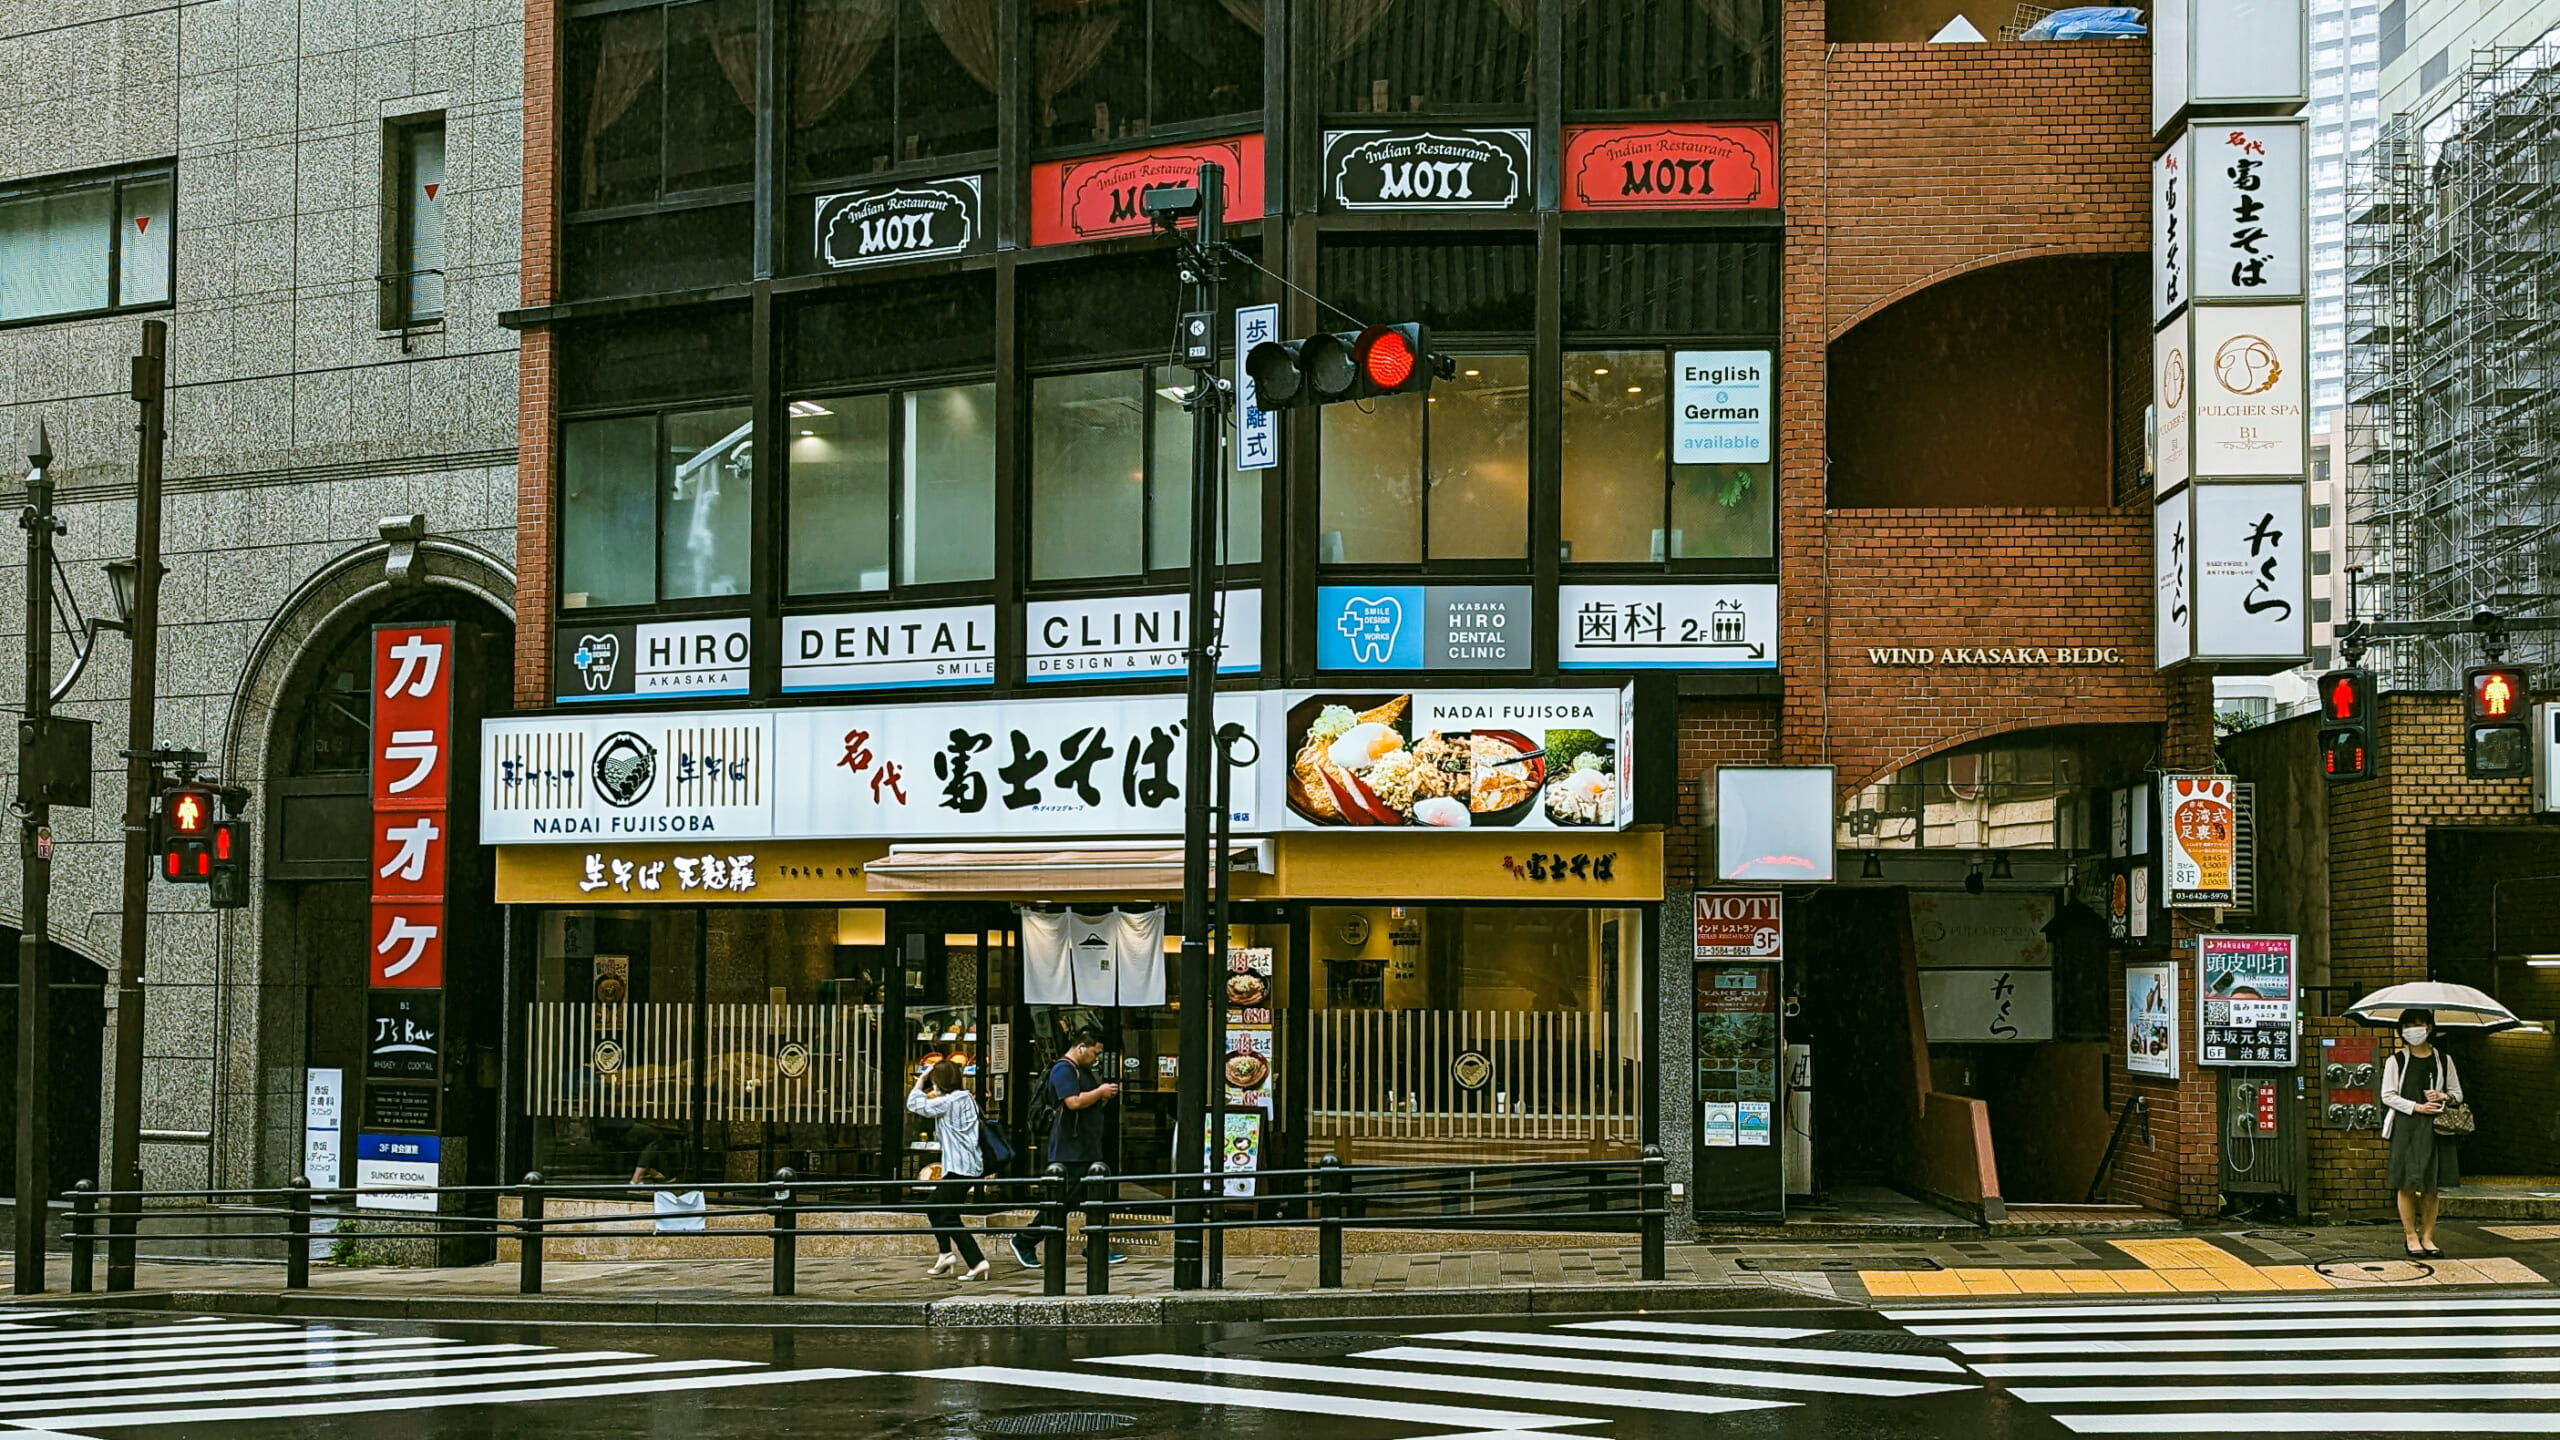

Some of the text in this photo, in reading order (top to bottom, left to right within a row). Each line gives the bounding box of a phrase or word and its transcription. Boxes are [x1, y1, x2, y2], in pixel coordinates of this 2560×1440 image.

[1365, 142, 1491, 164] Indian Restaurant
[1606, 139, 1732, 161] Indian Restaurant
[1097, 164, 1200, 190] Indian Restauran
[1379, 160, 1473, 200] MOTI
[1621, 158, 1715, 197] MOTI
[848, 197, 949, 224] Indian Restaurant
[2225, 131, 2274, 287] 名代 富士そば
[858, 212, 935, 255] MOTI
[1685, 366, 1760, 385] English
[1684, 404, 1759, 419] German
[2198, 404, 2300, 417] PULCHER SPA
[2239, 426, 2258, 439] B1
[1684, 435, 1760, 449] available
[2243, 513, 2292, 623] わくら
[1364, 607, 1390, 616] SMILE
[1449, 602, 1506, 611] AKASAKA
[1364, 616, 1390, 624] DESIGN
[1449, 614, 1506, 628] HIRO
[1578, 601, 1708, 643] 歯科 2F
[650, 607, 1220, 667] HIRO DENTAL CLINI
[1364, 633, 1390, 641] WORKS
[1449, 631, 1505, 643] DENTAL
[1449, 646, 1506, 659] CLINIC
[1868, 647, 2124, 665] WIND AKASAKA BLDG.
[936, 661, 994, 675] SMILE
[1039, 655, 1113, 671] DESIGN
[1127, 655, 1136, 667] &
[649, 673, 728, 687] AKASAKA
[1433, 706, 1594, 719] NADAI FUJISOBA
[677, 752, 750, 784] 生そば
[836, 718, 1188, 814] 名代 富士そば
[377, 635, 443, 979] カラオケ
[533, 815, 715, 834] NADAI FUJISOBA
[1229, 812, 1250, 822] 坂店
[2180, 808, 2228, 824] 台湾式
[2180, 824, 2212, 841] 足裏
[579, 853, 665, 893] 生そば
[1526, 852, 1617, 881] 富士そば
[2176, 870, 2195, 883] 8F
[1697, 897, 1779, 920] MOTI
[1698, 924, 1757, 933] インド レストラン
[1756, 932, 1777, 949] 3F
[2206, 953, 2288, 974] 頭皮叩打
[375, 1018, 434, 1043] J's Bar
[2206, 1029, 2288, 1045] 赤坂元気堂
[2209, 1048, 2224, 1057] 6F
[2240, 1046, 2287, 1060] 治療院
[379, 1143, 390, 1152] 3F
[400, 1172, 425, 1182] ROOM
